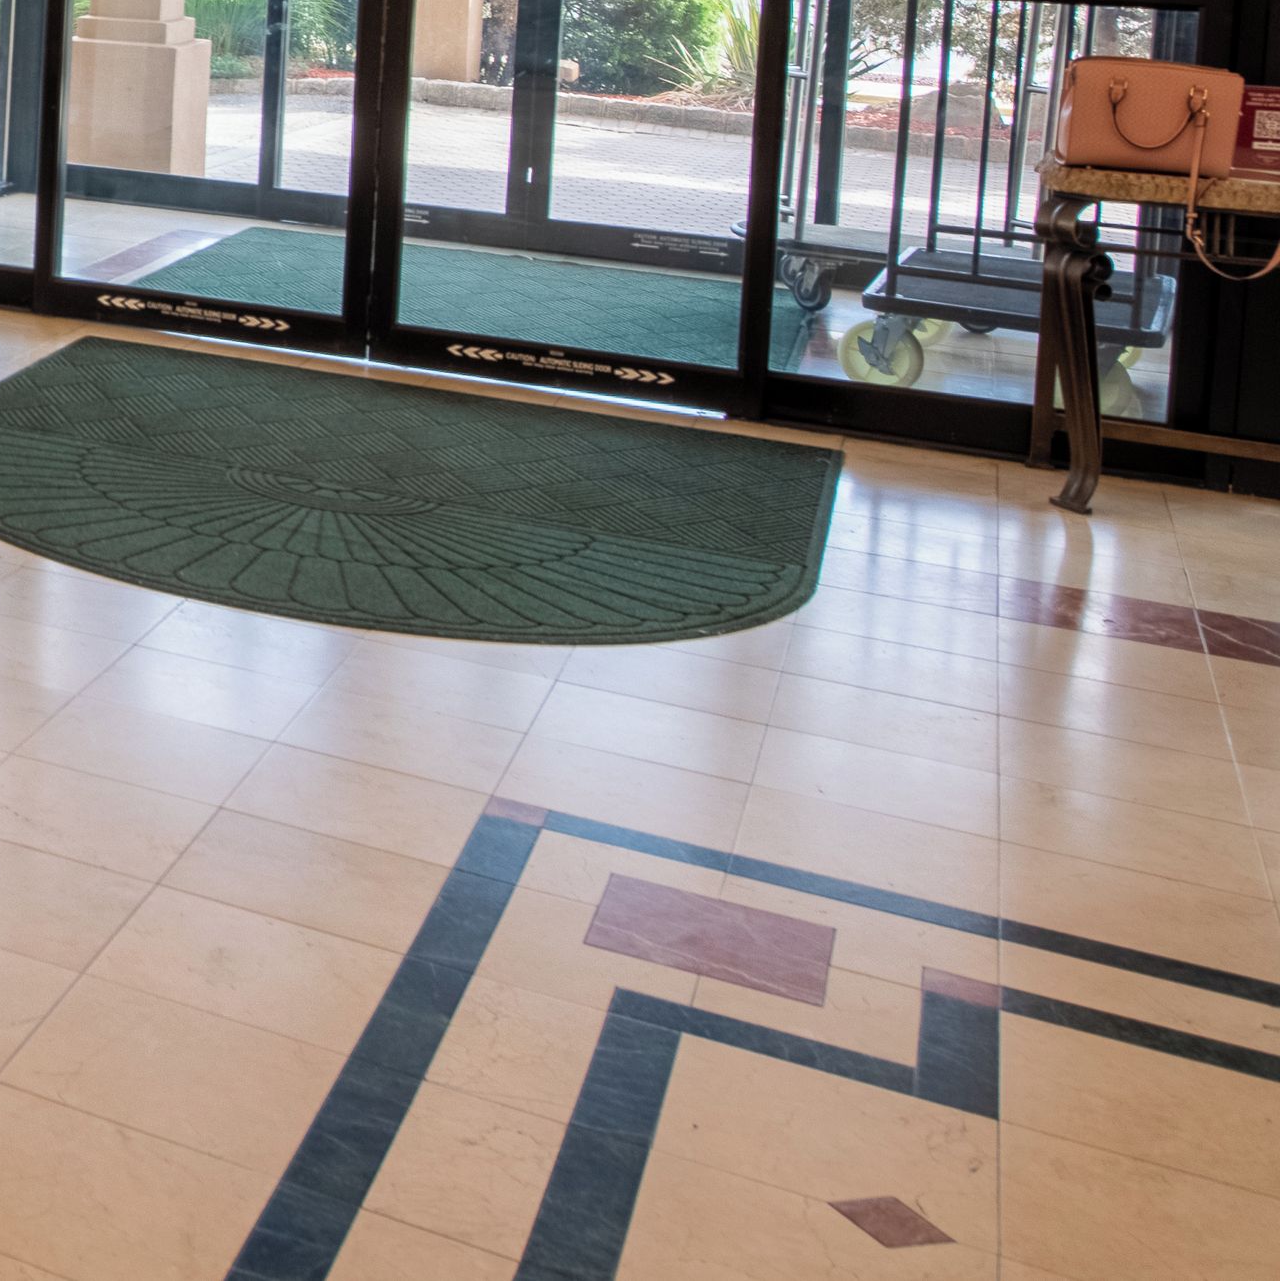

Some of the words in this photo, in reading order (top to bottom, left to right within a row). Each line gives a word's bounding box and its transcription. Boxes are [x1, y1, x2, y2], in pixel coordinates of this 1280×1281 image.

[505, 352, 536, 363] CAUTION
[540, 356, 571, 368] AUTOMATIC
[572, 360, 594, 371] SLIDING
[594, 363, 612, 373] DOOR
